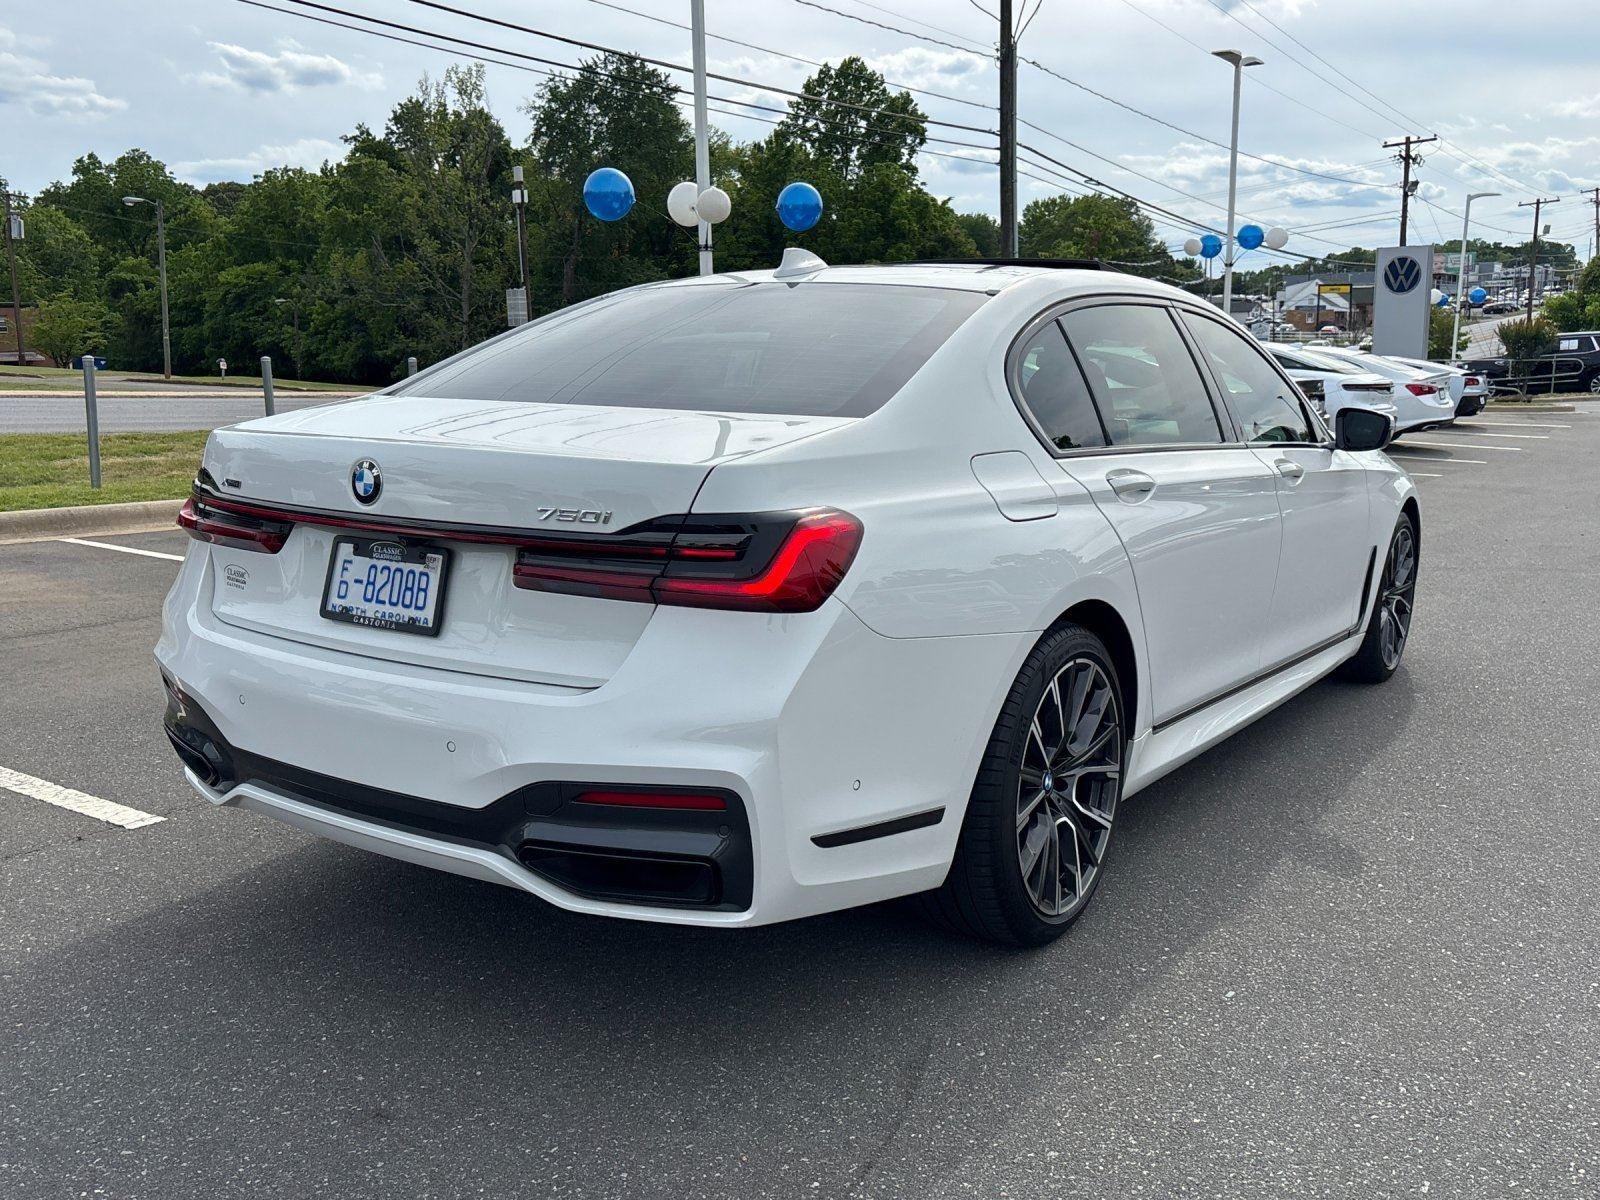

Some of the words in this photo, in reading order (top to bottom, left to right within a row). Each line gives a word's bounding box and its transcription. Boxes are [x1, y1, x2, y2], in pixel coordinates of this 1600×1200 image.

[537, 507, 613, 525] 750i
[372, 545, 403, 556] CLASSIC
[331, 603, 367, 614] NORTH
[373, 609, 429, 626] CAROLNA
[352, 615, 397, 630] GASTONIA
